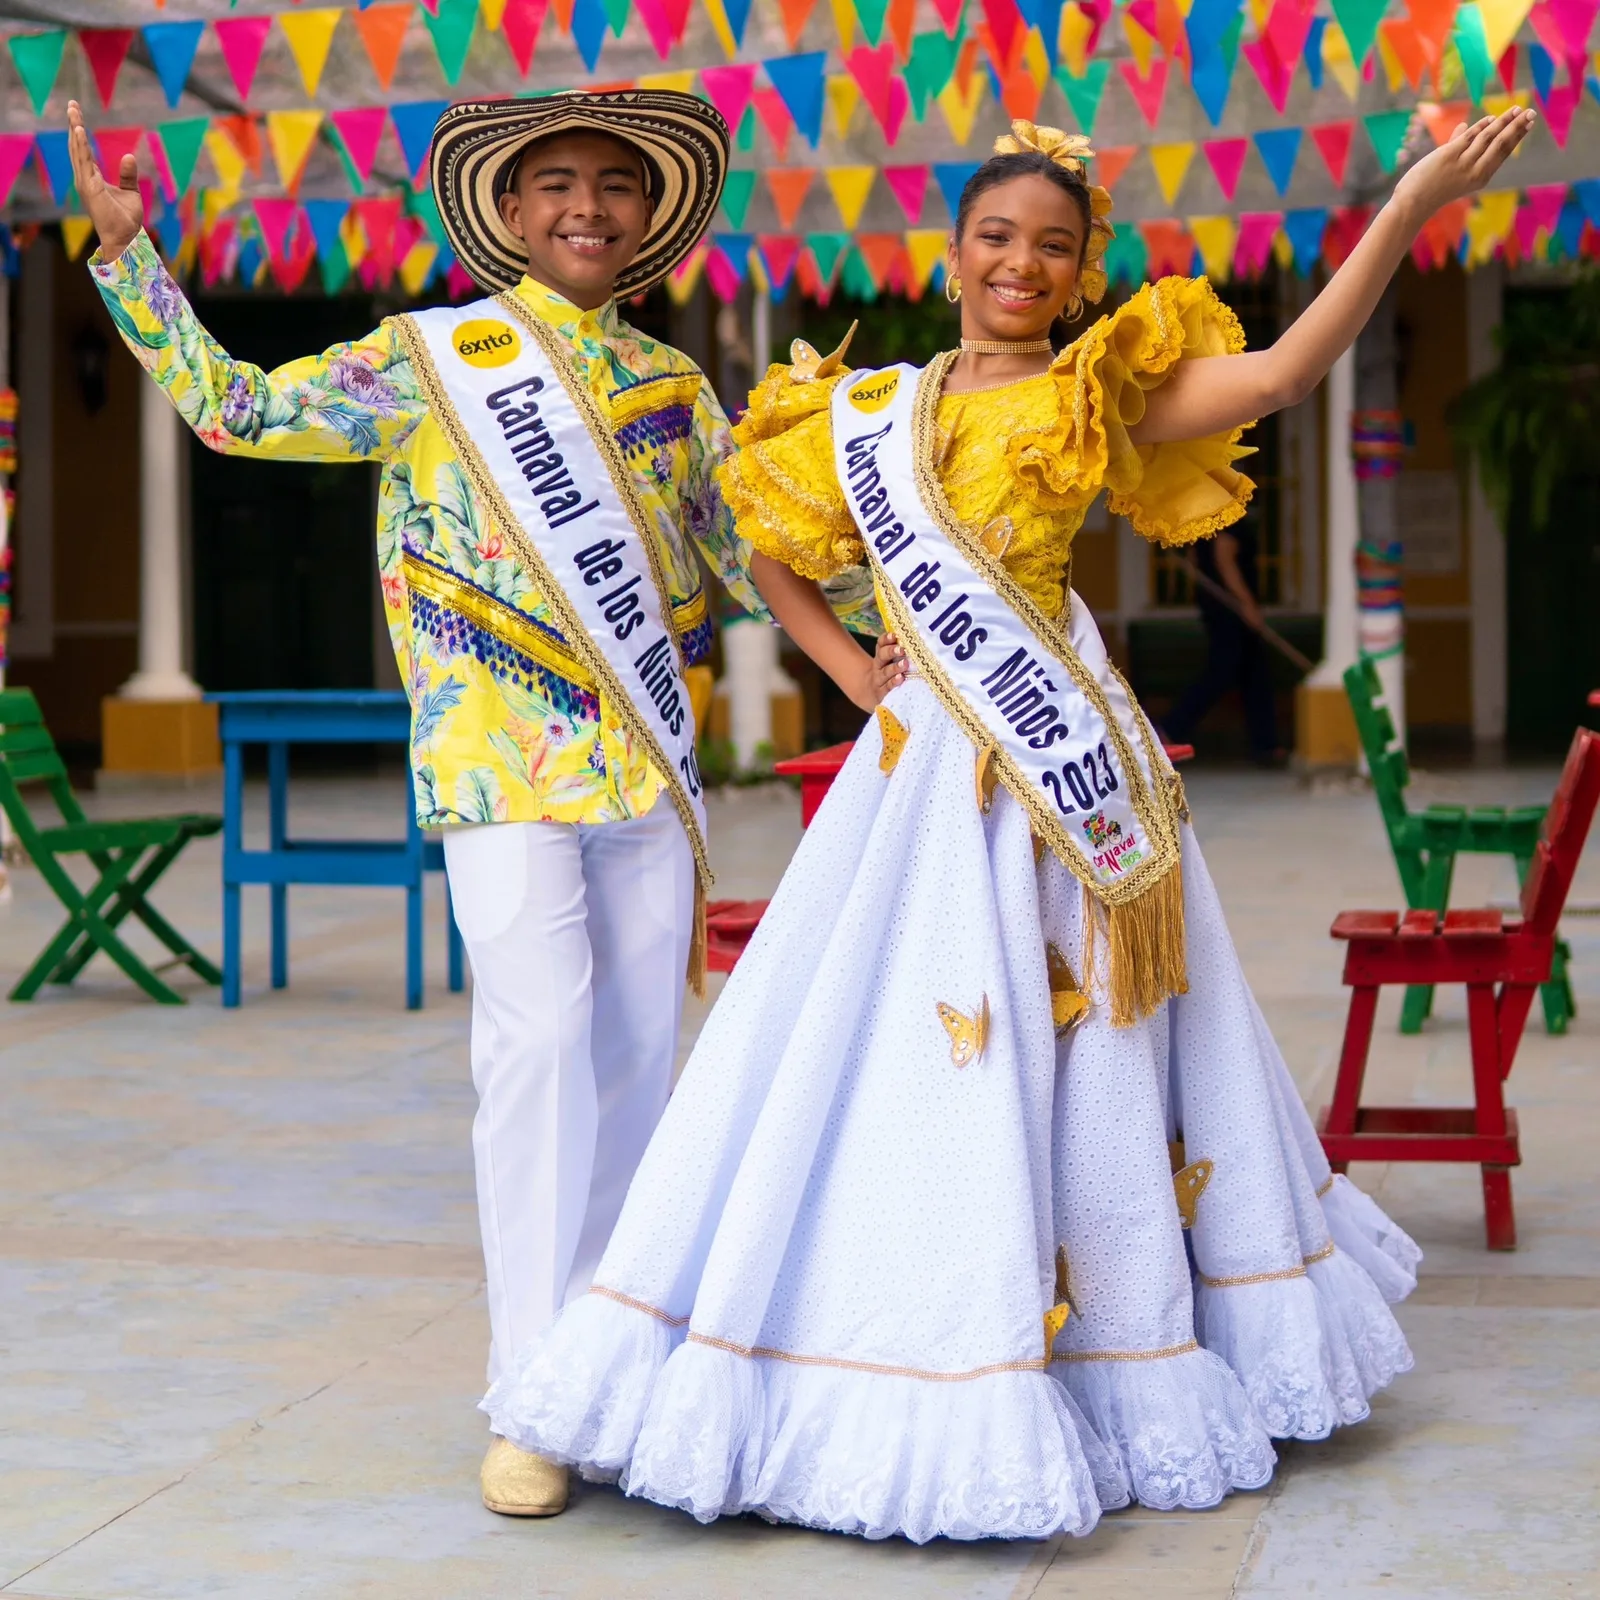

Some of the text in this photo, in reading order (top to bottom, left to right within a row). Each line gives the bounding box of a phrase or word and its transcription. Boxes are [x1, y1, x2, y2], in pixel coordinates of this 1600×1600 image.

[459, 334, 513, 356] éxito
[852, 378, 898, 401] éxito
[485, 375, 685, 737] Carnaval de los Niños
[844, 420, 1070, 750] Carnaval de los Niños
[680, 743, 702, 798] 20
[1041, 742, 1119, 815] 2023
